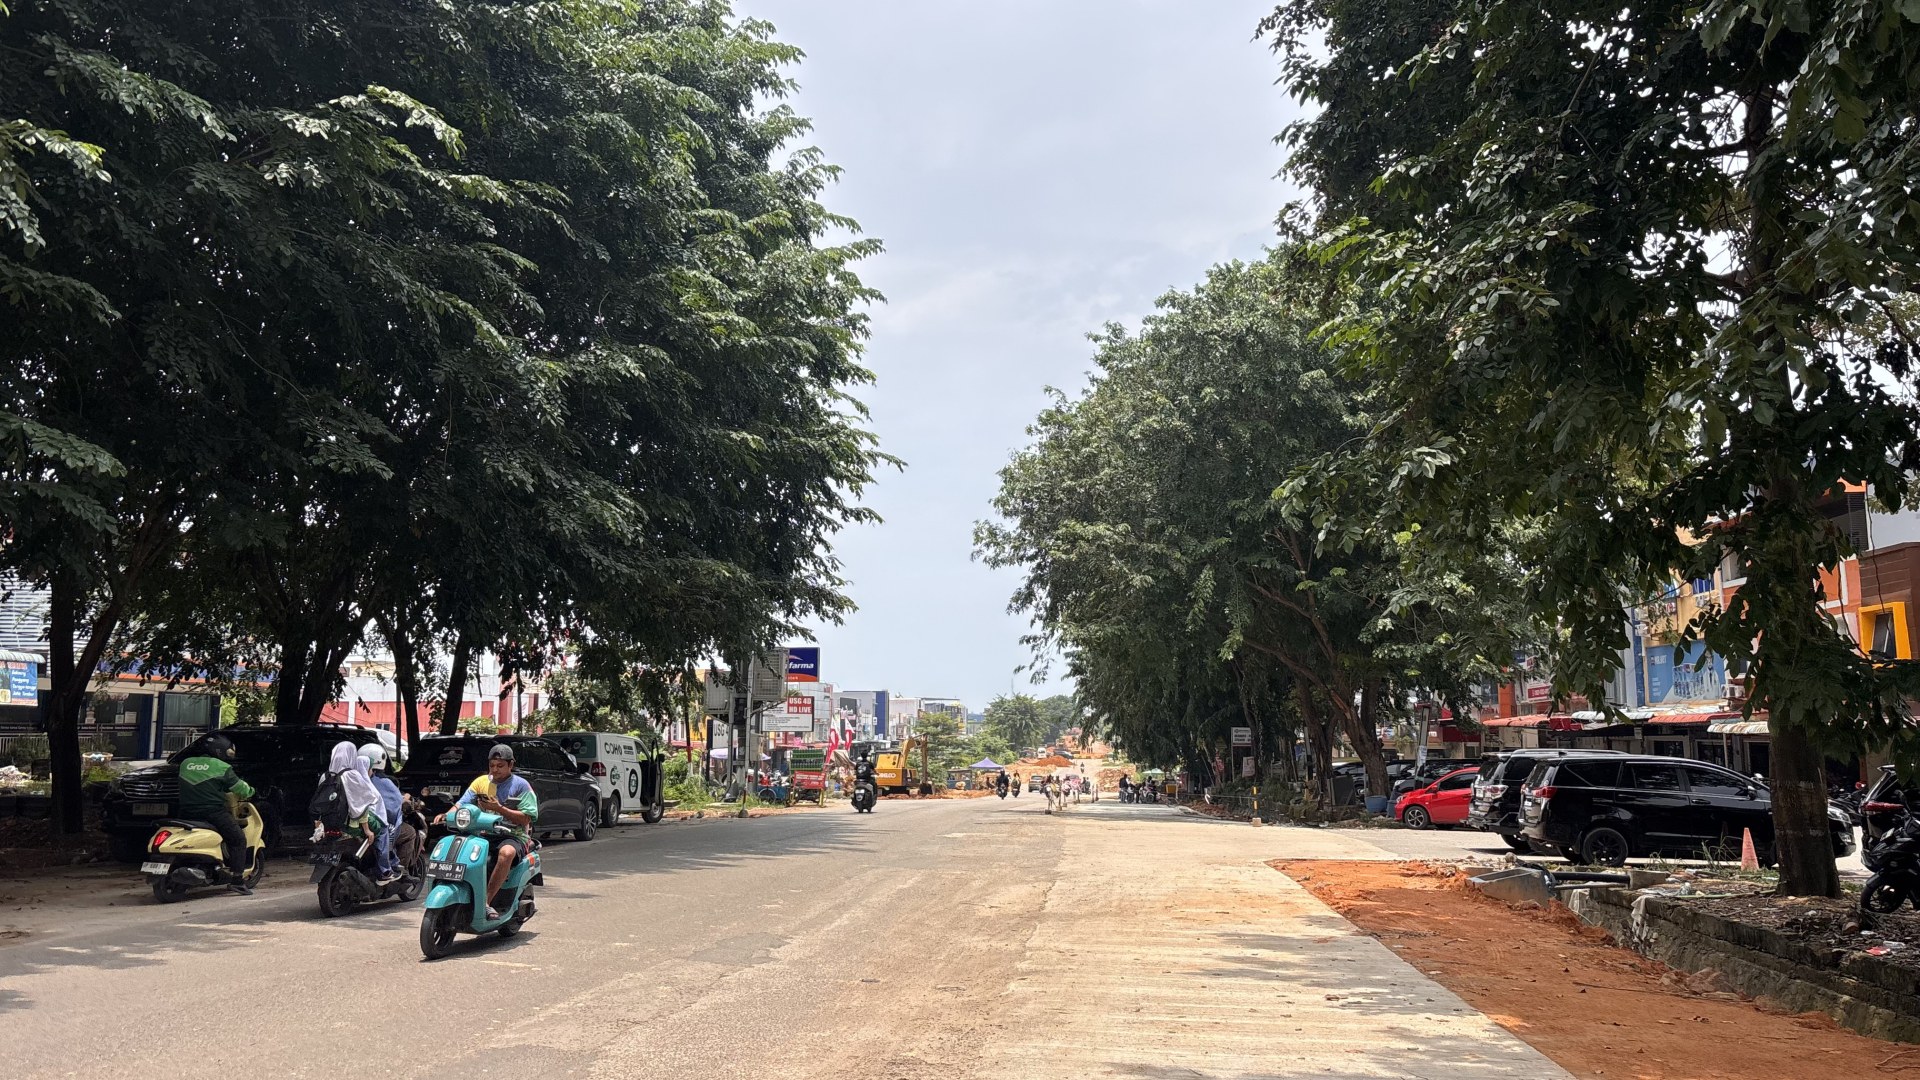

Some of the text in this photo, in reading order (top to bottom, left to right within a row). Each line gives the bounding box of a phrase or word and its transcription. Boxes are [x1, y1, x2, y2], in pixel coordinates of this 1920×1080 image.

[788, 661, 814, 669] farma
[713, 723, 725, 737] USG
[186, 762, 210, 771] Grab
